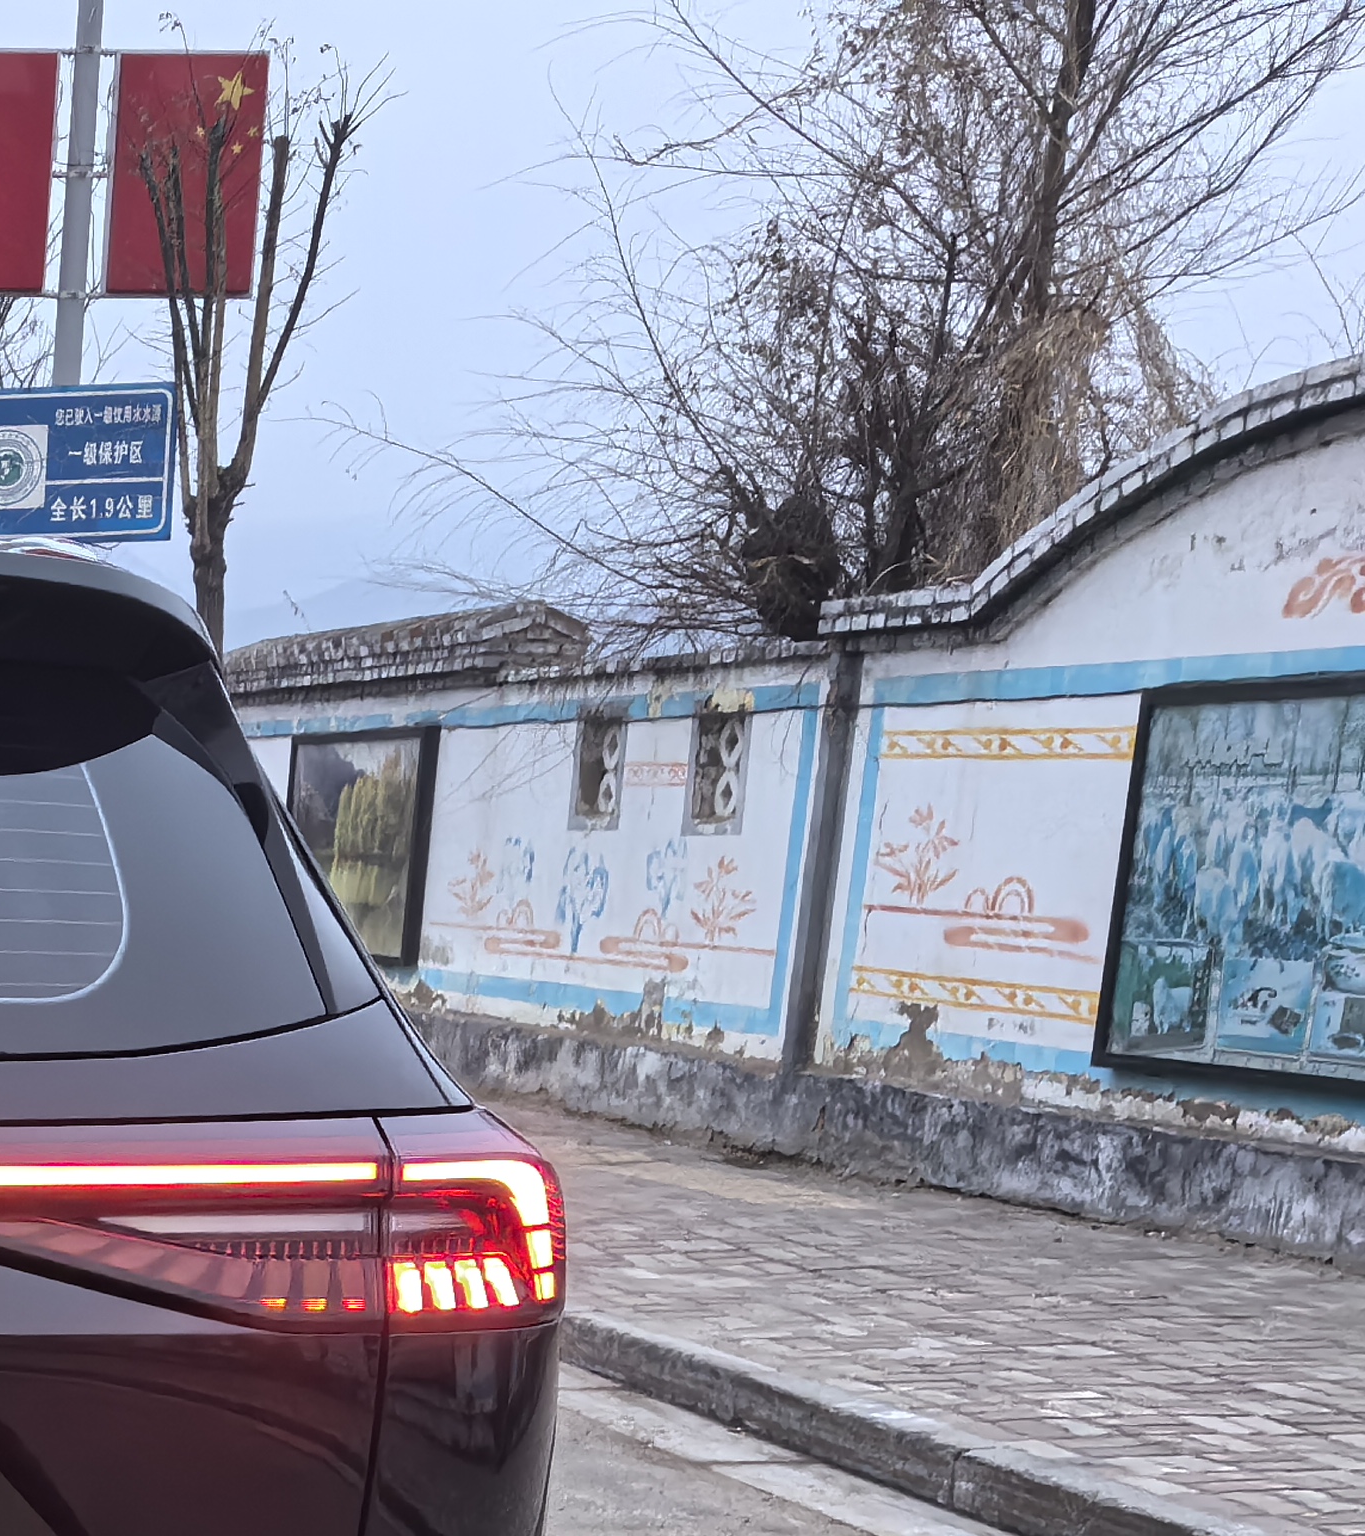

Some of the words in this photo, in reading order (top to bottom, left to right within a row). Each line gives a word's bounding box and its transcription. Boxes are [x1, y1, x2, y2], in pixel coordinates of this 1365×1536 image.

[68, 440, 143, 465] 一级保护区
[49, 494, 153, 522] 全长1.9公里
